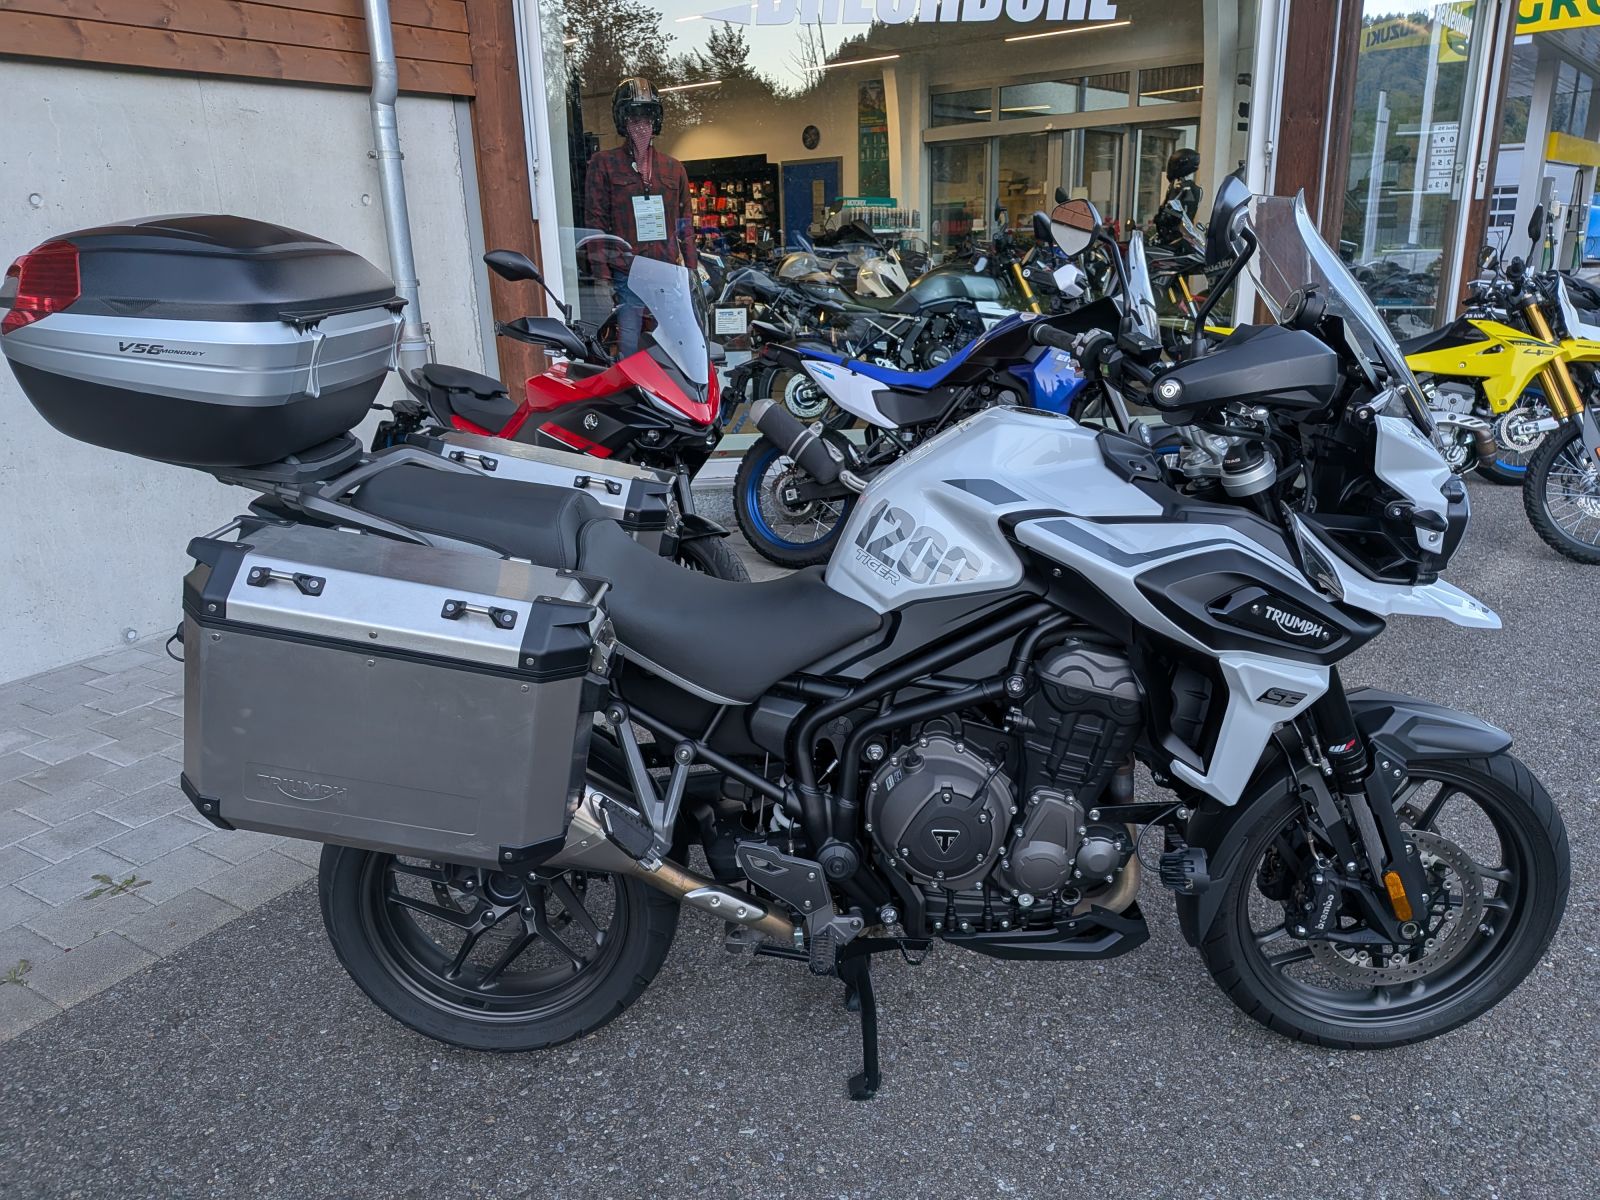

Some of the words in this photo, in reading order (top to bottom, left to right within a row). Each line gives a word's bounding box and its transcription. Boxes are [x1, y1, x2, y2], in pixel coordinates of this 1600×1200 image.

[160, 348, 206, 356] MONOKEY
[856, 548, 901, 586] TIGER
[1265, 605, 1323, 638] TRIUMPH
[256, 773, 349, 805] TRIUMPH
[1314, 894, 1335, 930] brembo
